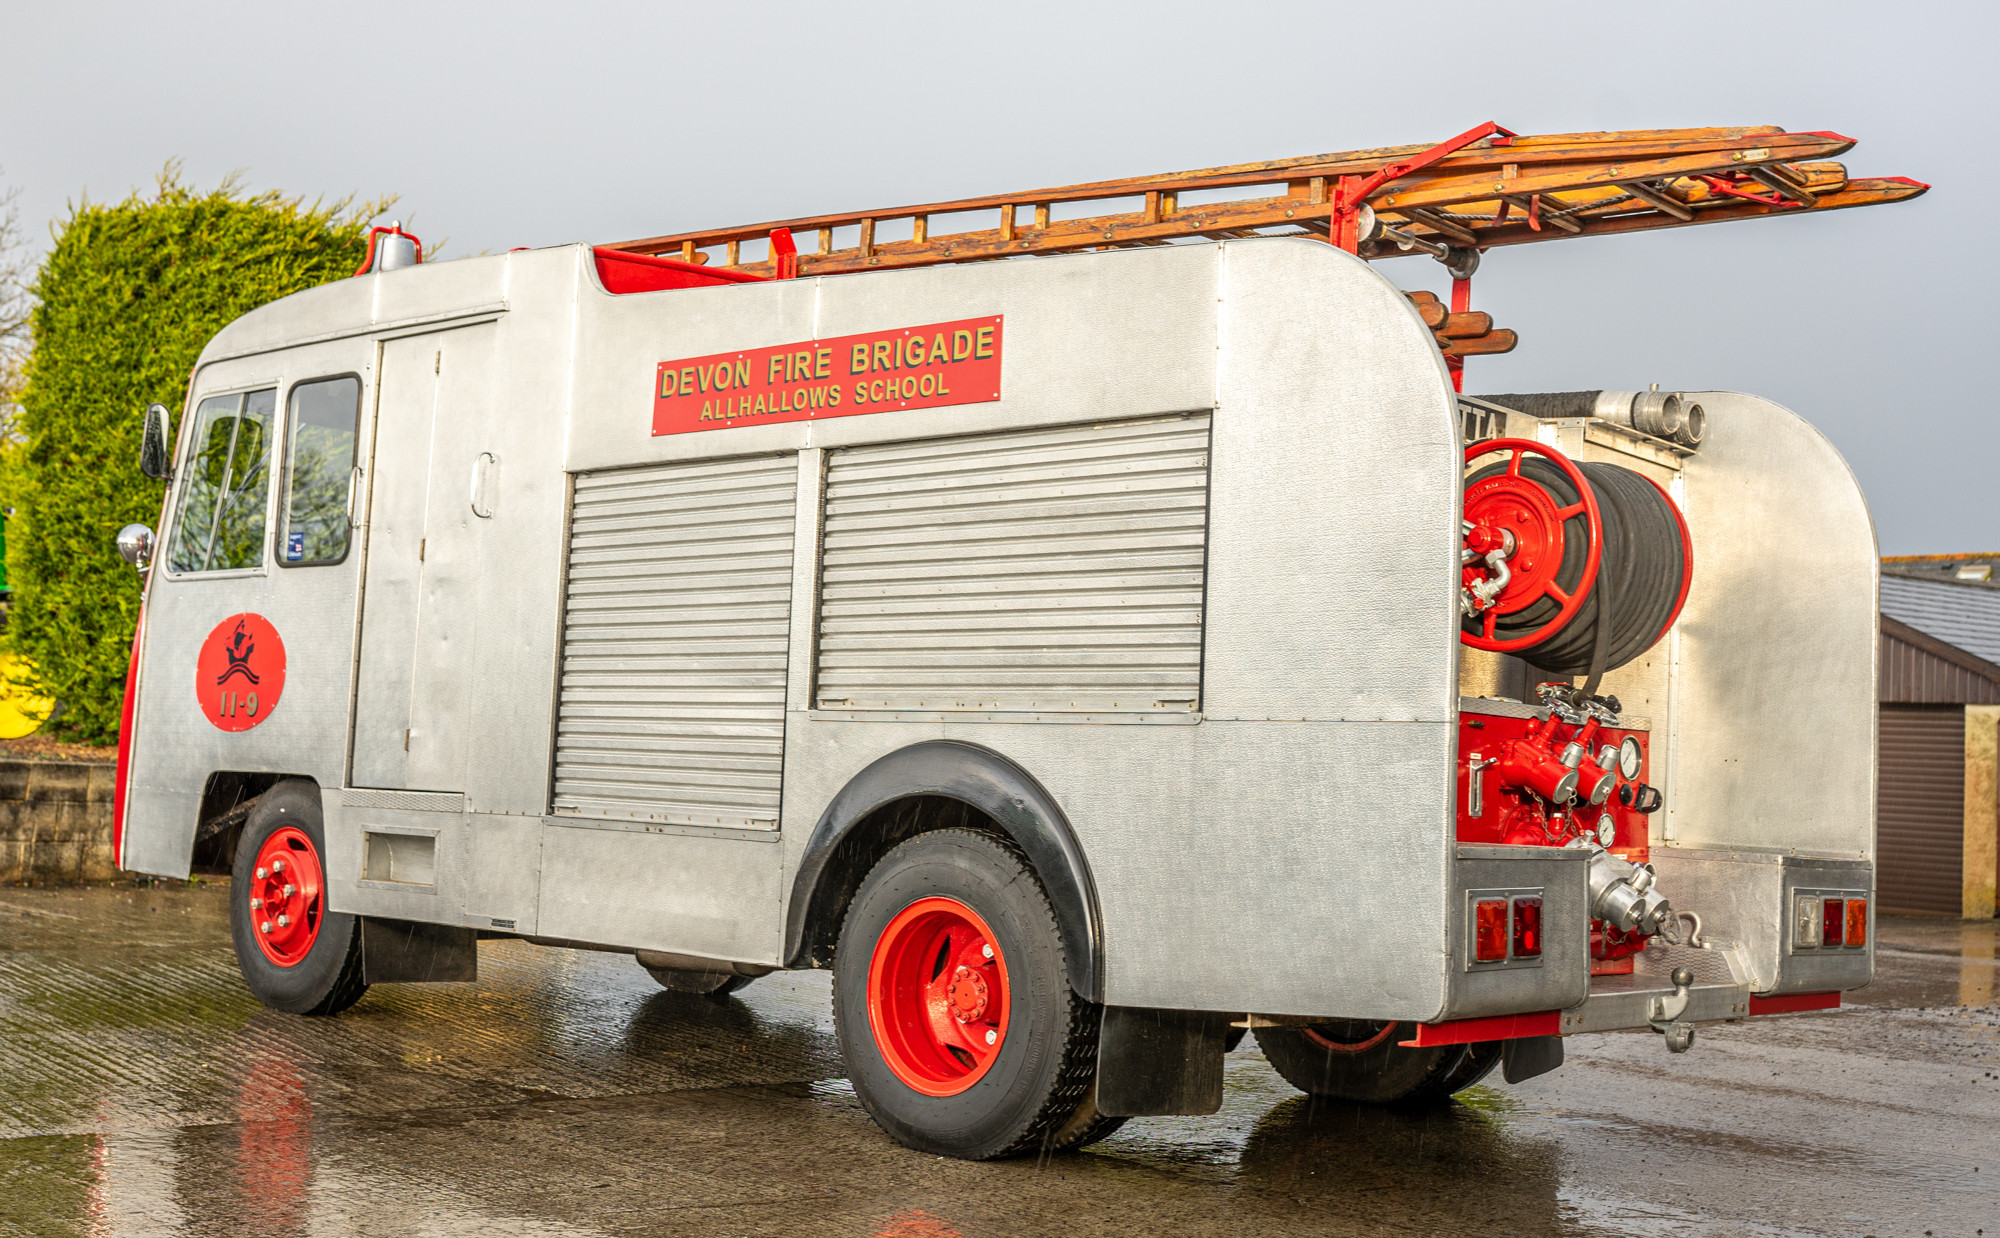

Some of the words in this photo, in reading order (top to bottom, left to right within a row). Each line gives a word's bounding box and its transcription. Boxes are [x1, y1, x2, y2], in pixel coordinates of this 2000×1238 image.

[661, 359, 751, 399] DEVON
[767, 348, 832, 386] FIRE
[850, 326, 995, 376] BRIGADE
[699, 385, 842, 422] ALLHALLOWS
[854, 373, 950, 405] SCHOOL
